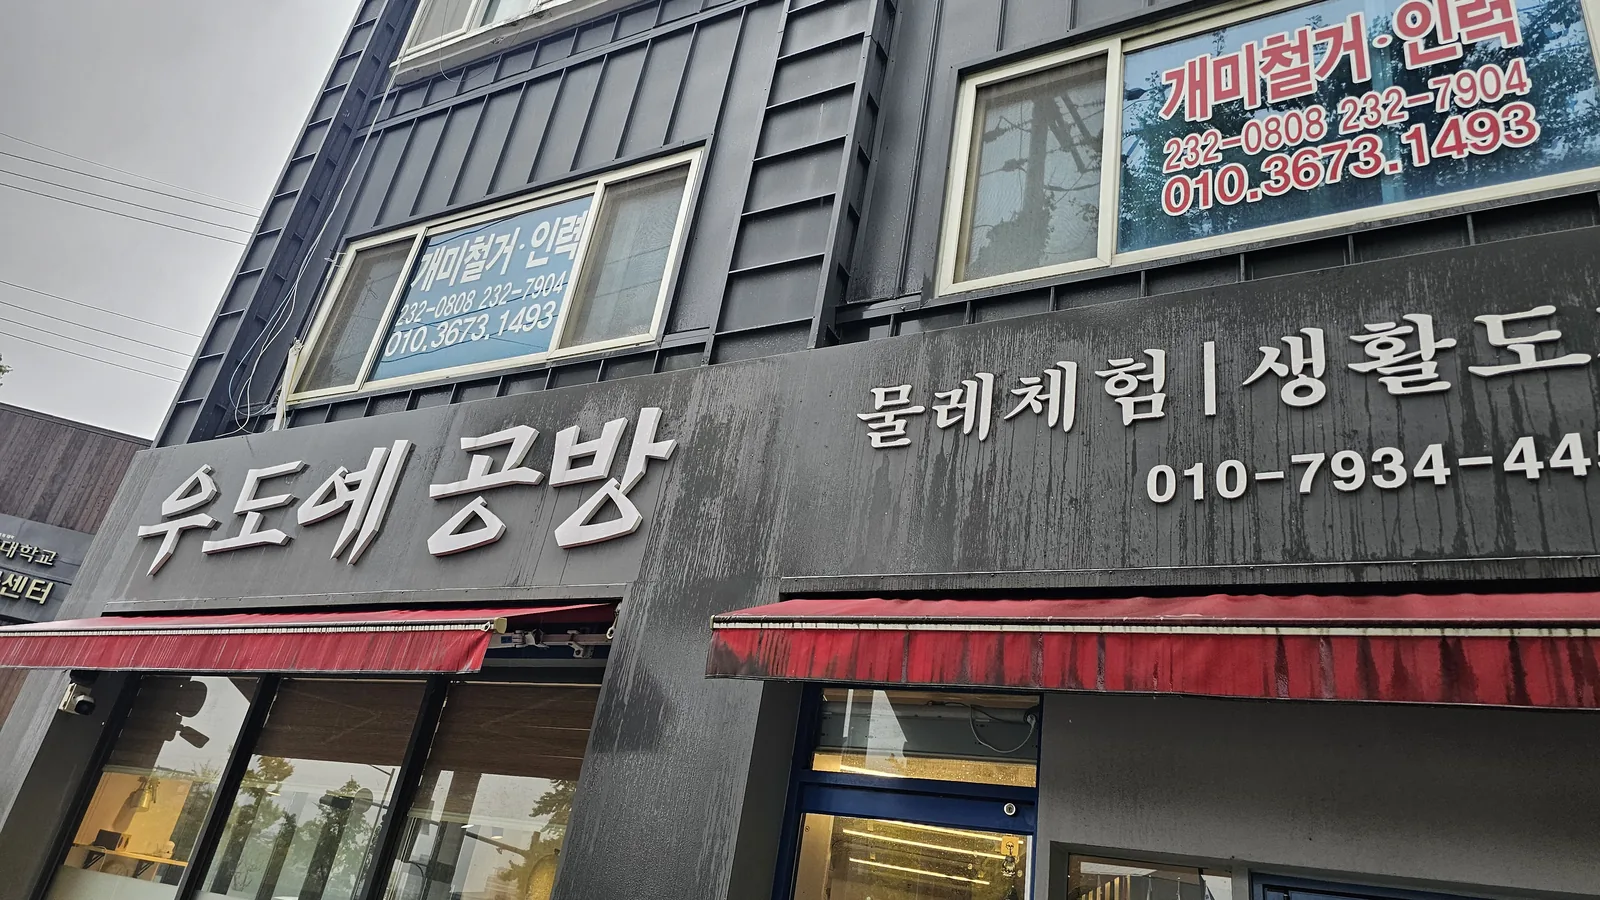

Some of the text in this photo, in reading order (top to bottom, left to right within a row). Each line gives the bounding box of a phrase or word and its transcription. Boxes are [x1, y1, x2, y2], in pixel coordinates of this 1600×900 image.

[1161, 102, 1540, 217] 010.3673.1493
[1162, 57, 1532, 173] 232-0808 232-7904
[384, 301, 557, 357] 010.3673.1493
[395, 270, 569, 327] 232-0808 232-7904
[857, 347, 1167, 449] 물레체험
[1243, 304, 1600, 407] 생활도
[137, 406, 678, 577] 우도예 공방
[1146, 430, 1600, 504] 010-7934-44
[0, 571, 54, 604] 센터
